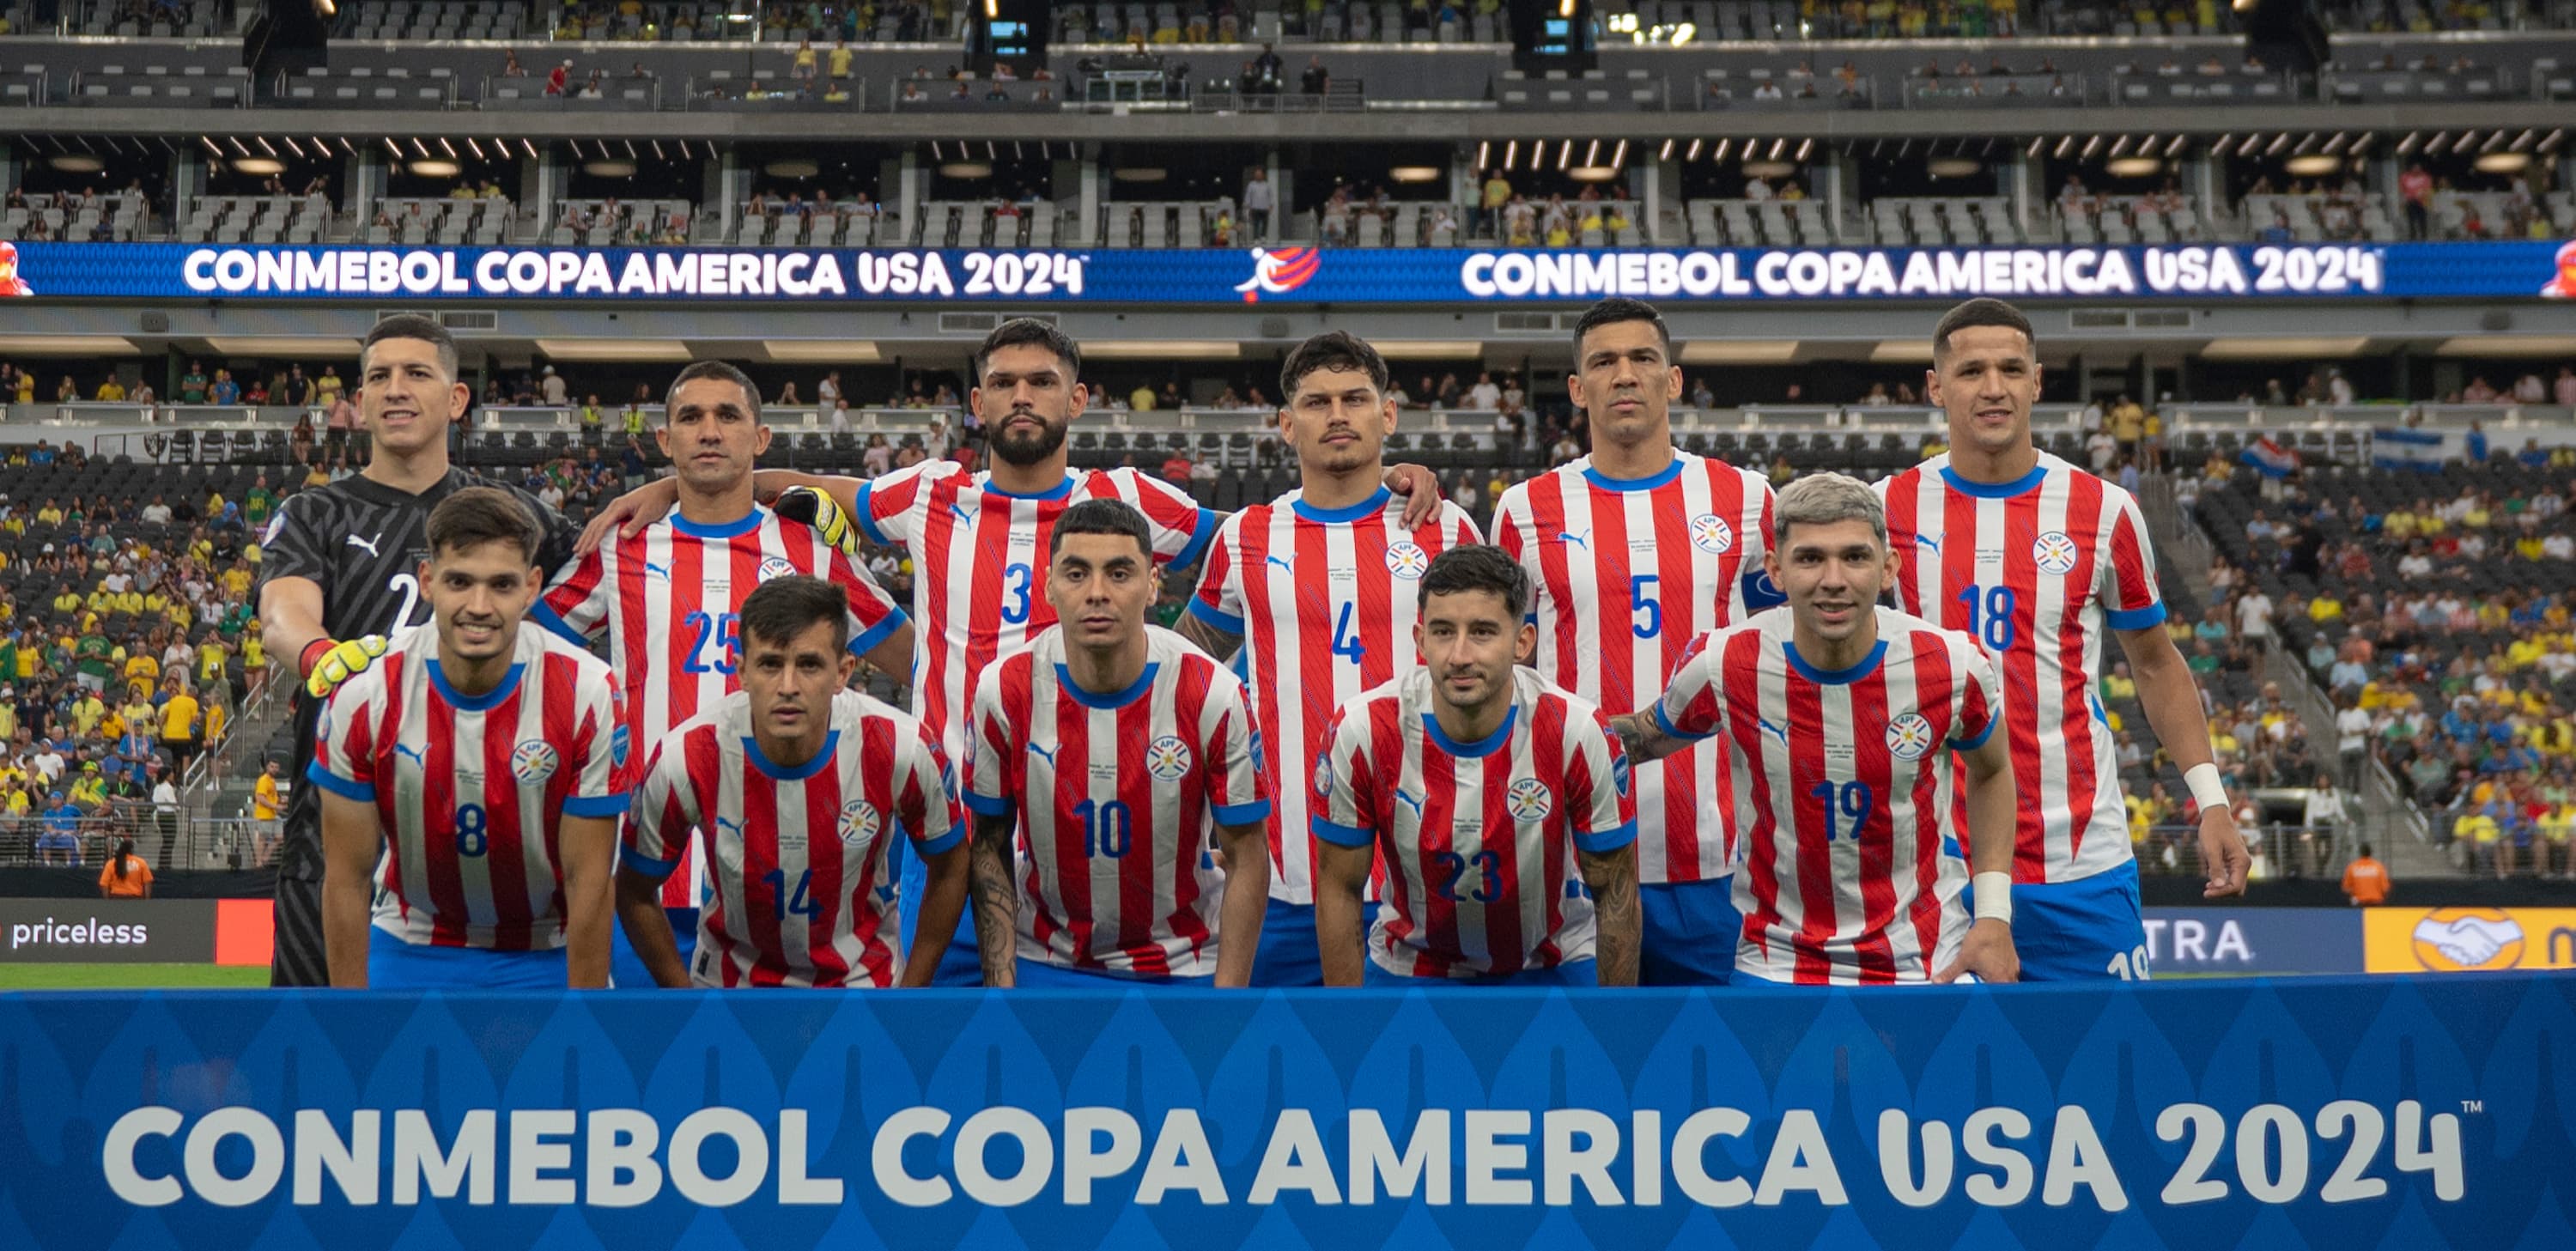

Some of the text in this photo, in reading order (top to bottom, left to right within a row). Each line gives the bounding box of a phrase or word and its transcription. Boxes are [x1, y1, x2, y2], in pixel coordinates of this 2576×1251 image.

[183, 249, 1083, 297] CONMEBOL COPA AMERICA USA 2024
[1461, 246, 2379, 297] CONMEBOL COPA AMERICA USA 2024
[1002, 562, 1031, 624] 3
[1631, 574, 1660, 639] 5
[1958, 584, 2014, 651] 18
[683, 610, 741, 675] 25
[1333, 601, 1366, 665] 4
[456, 802, 489, 858] 8
[1073, 799, 1132, 859] 10
[1811, 780, 1873, 841] 19
[762, 869, 824, 922] 14
[1436, 850, 1503, 903] 23
[13, 916, 148, 950] priceless
[104, 1107, 844, 1207] CONMEBOL
[872, 1107, 1229, 1206] COPA
[1247, 1108, 1850, 1207] AMERICA
[1879, 1107, 2128, 1212] USA
[2156, 1100, 2465, 1205] 2024
